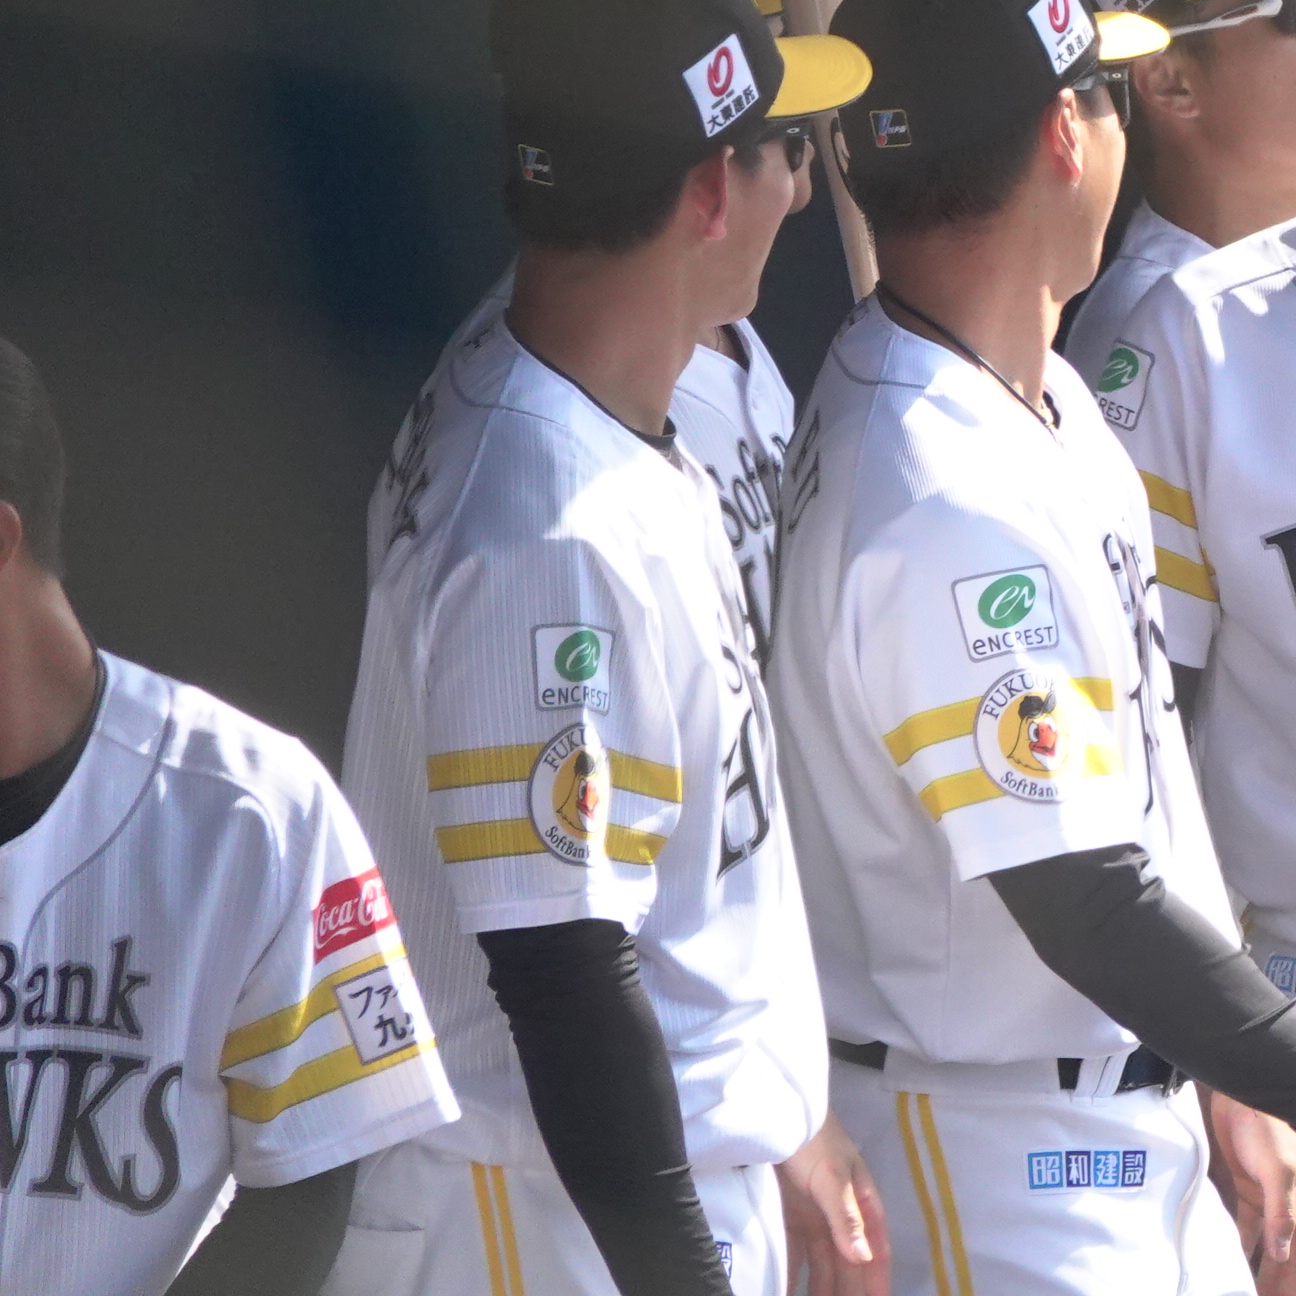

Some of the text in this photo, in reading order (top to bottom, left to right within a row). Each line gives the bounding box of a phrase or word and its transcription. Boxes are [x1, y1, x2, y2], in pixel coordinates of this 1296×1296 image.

[1096, 394, 1136, 425] REST
[1028, 1150, 1147, 1190] 昭和建設
